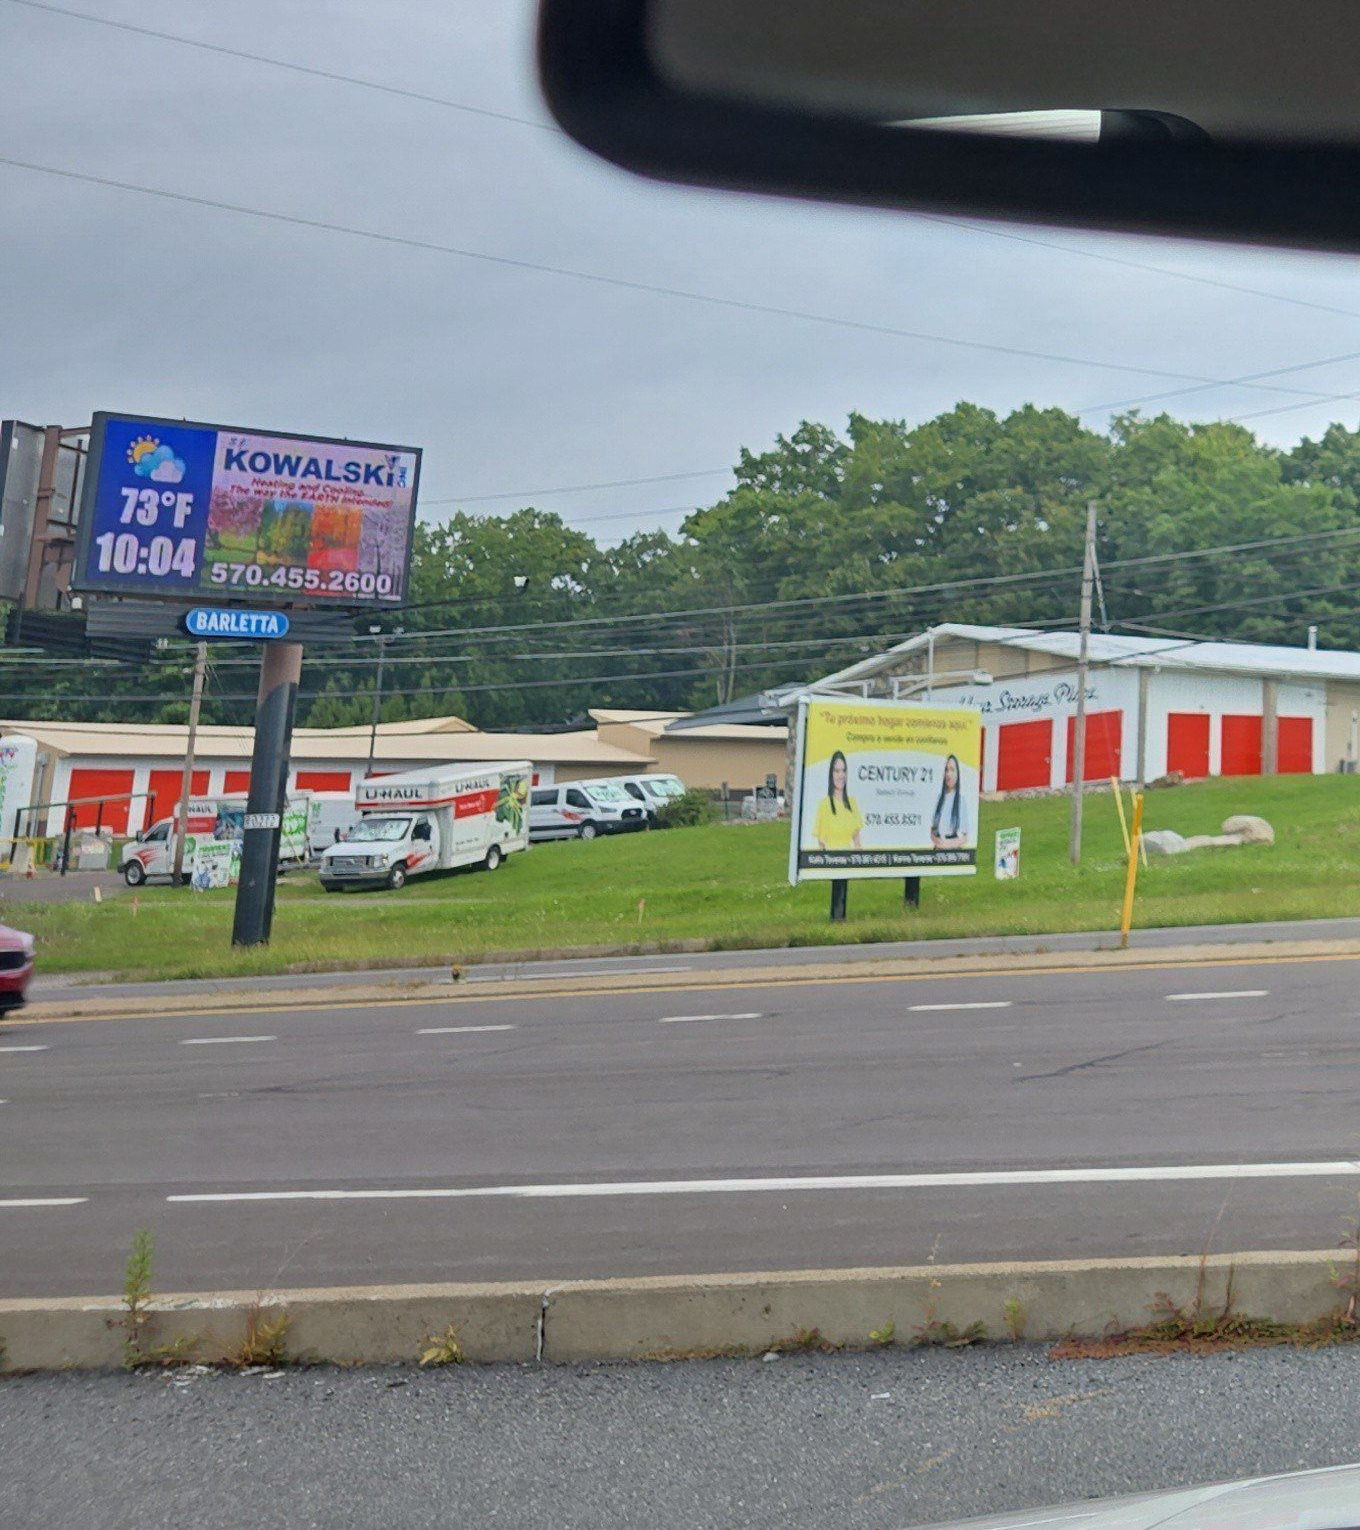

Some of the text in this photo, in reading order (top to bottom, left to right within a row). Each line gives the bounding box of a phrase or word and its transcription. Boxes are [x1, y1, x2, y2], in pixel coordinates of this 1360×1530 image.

[120, 486, 194, 528] 73°F
[96, 532, 197, 578] 10:04
[210, 562, 392, 594] 570.455.2600
[196, 611, 279, 634] BARLETTA
[858, 765, 933, 783] CENTURY 21
[365, 788, 423, 800] U-HAUL
